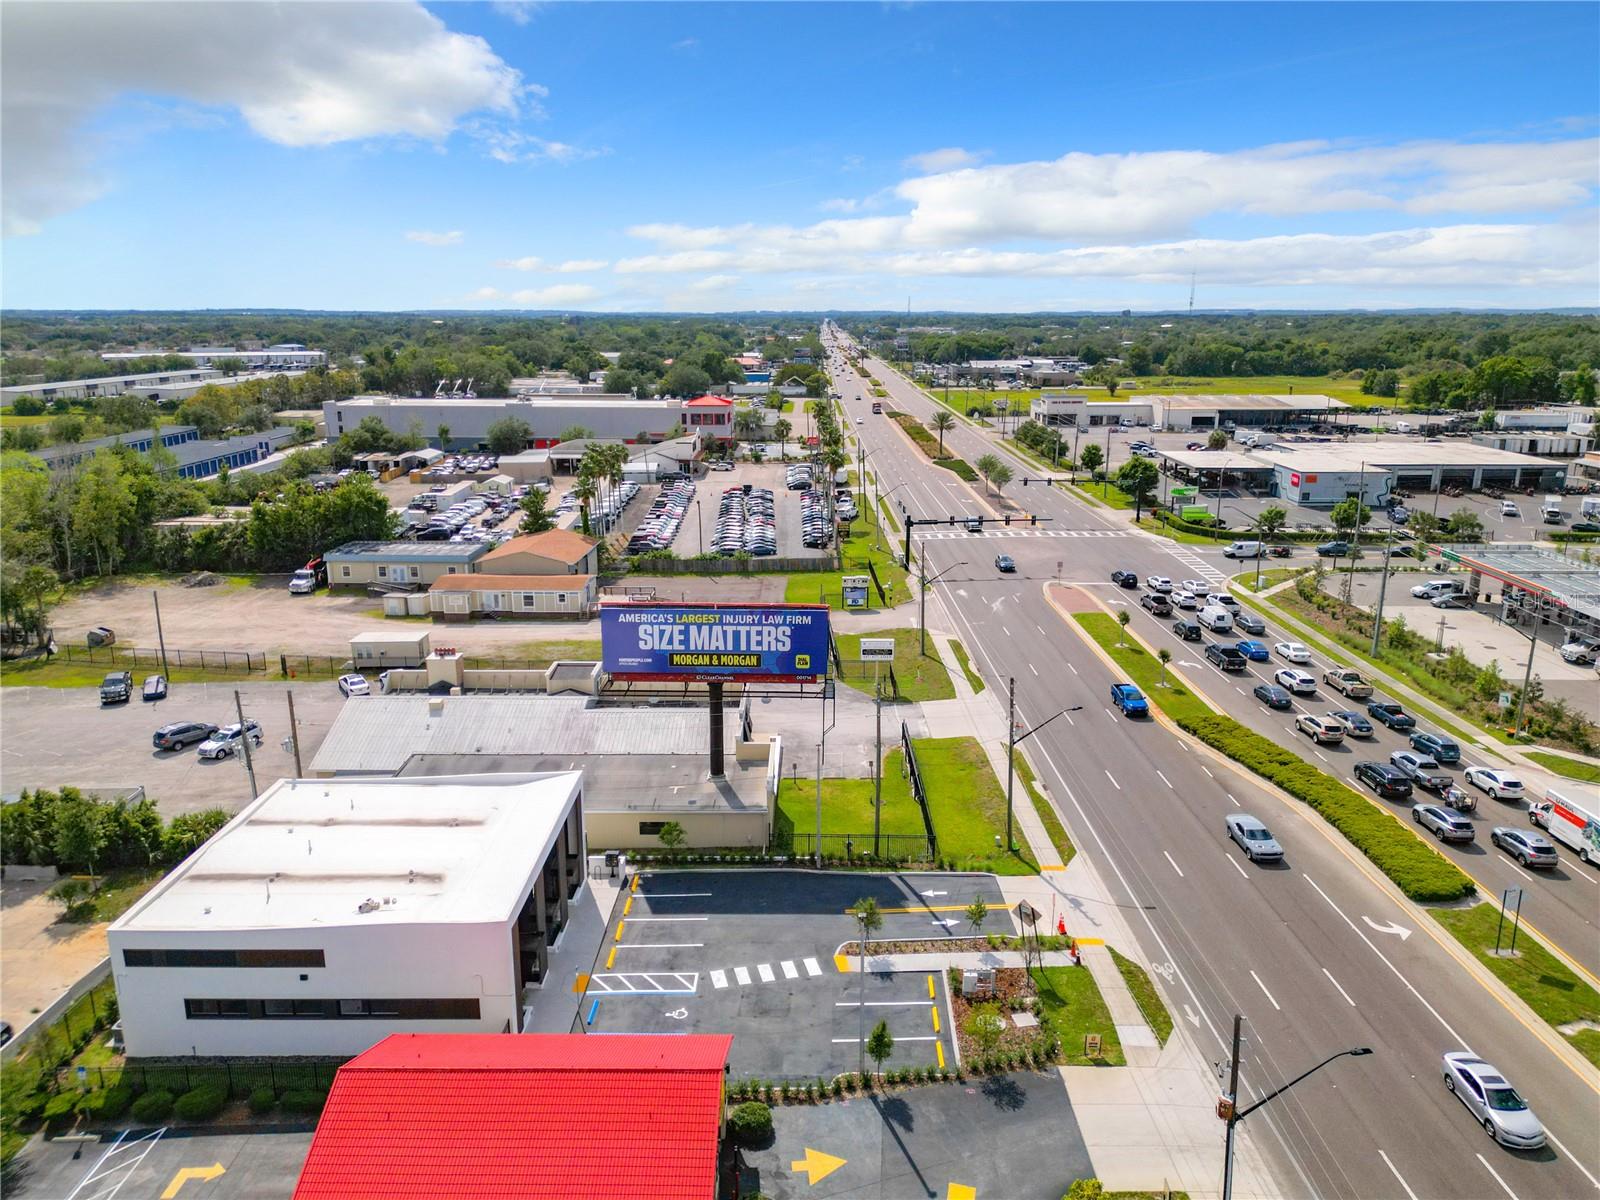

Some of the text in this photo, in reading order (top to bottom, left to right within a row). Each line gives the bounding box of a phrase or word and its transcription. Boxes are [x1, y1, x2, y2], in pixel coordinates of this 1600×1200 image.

[618, 613, 811, 624] AMERICA'S LARGEST INJURY LAW FIRM
[638, 624, 791, 652] SIZE MATTERS
[673, 654, 757, 666] MORGAN & MORGAN
